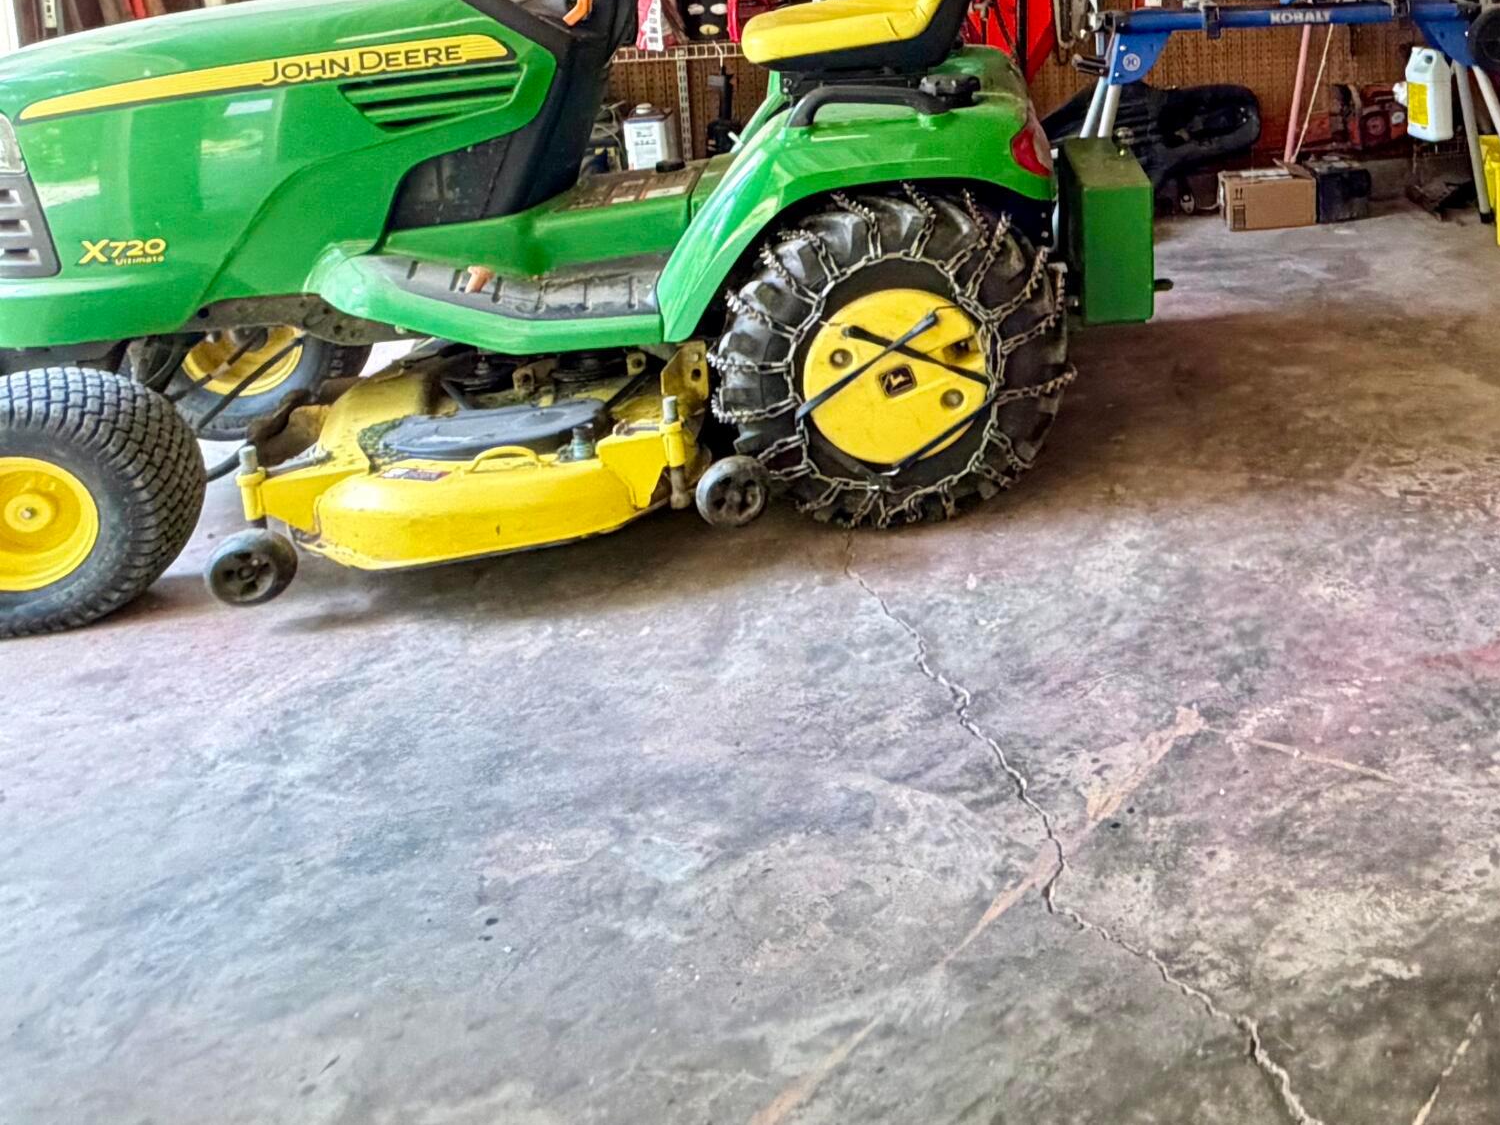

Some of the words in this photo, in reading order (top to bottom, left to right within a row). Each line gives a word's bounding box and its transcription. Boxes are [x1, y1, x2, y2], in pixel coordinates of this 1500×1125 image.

[1270, 10, 1331, 25] KOBALT
[262, 57, 350, 83] JOHN
[359, 45, 463, 71] DEERE
[79, 239, 166, 264] X720
[115, 255, 165, 266] Ultimate
